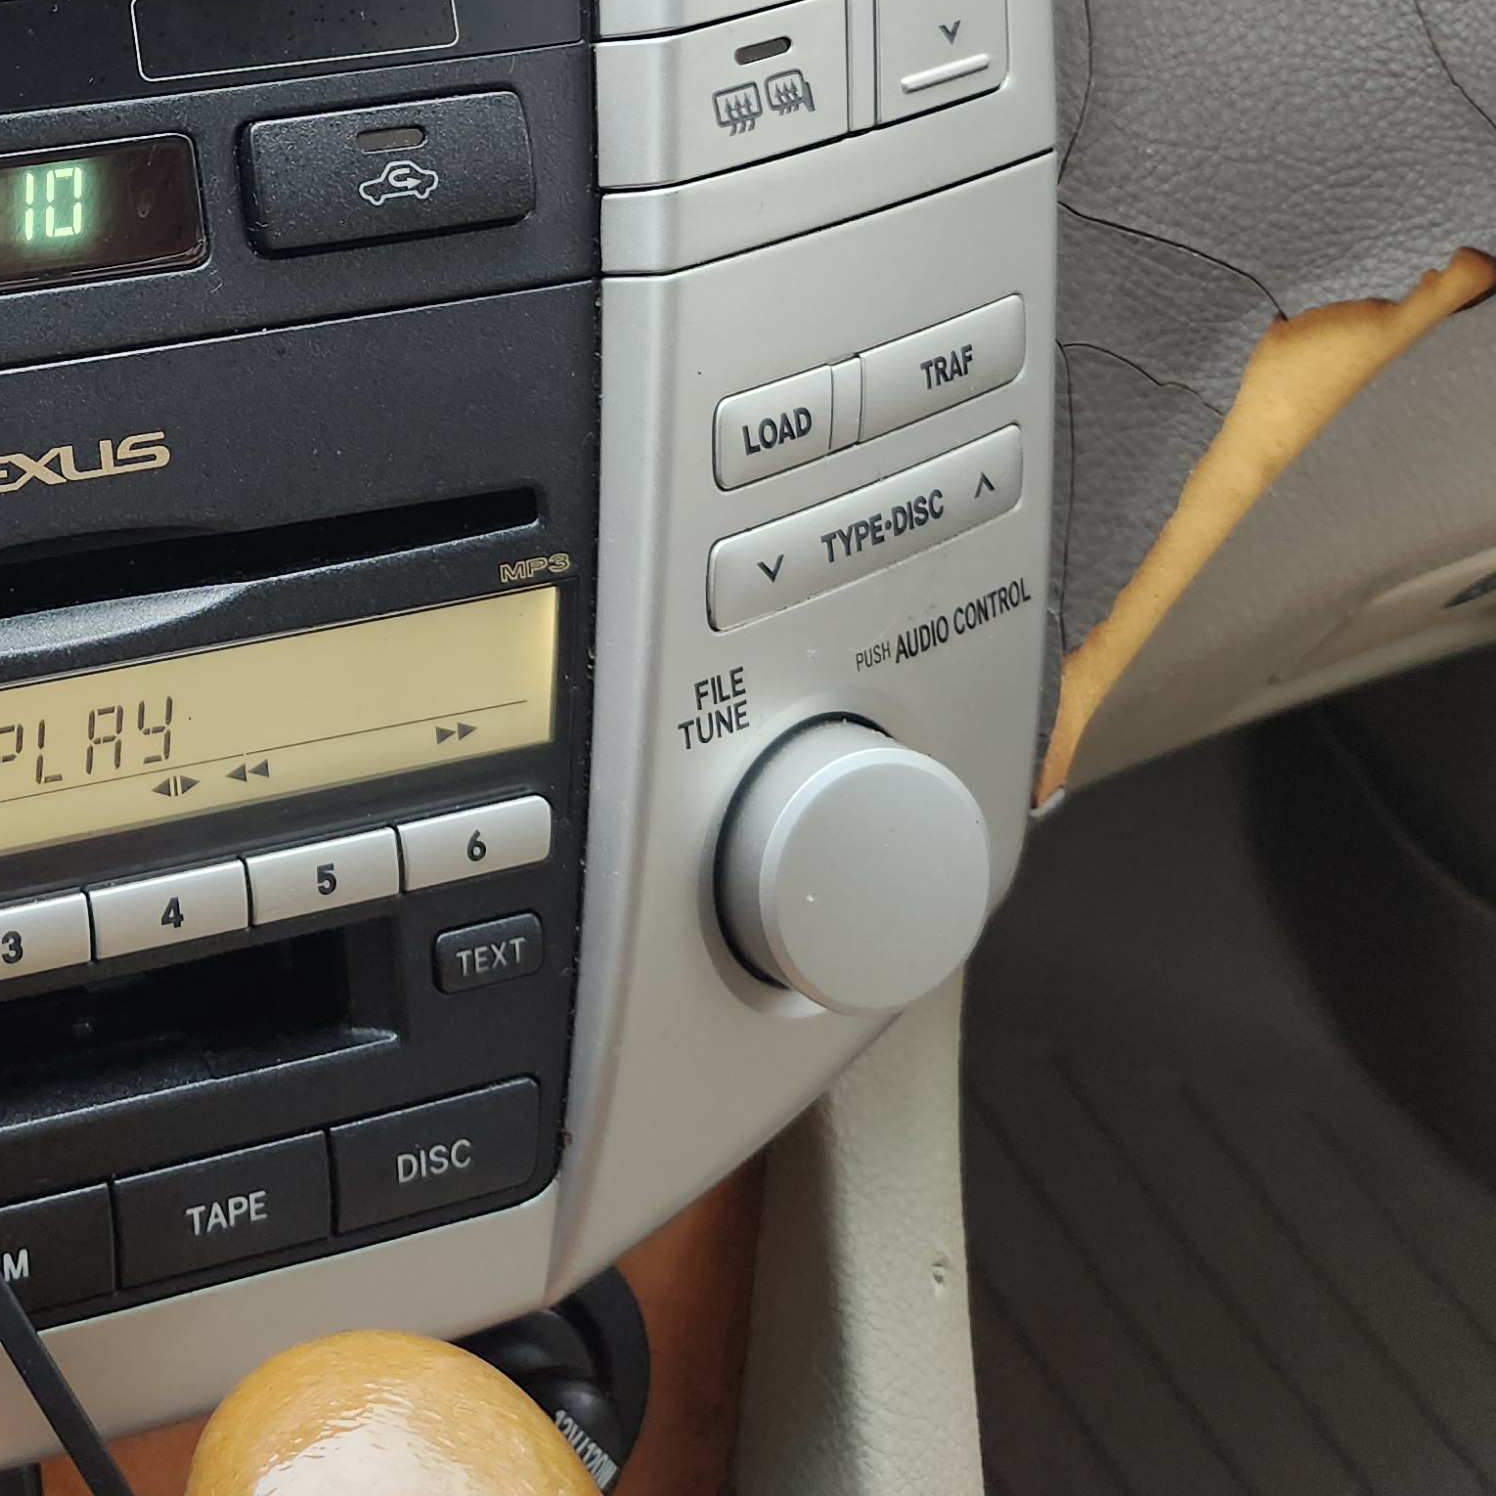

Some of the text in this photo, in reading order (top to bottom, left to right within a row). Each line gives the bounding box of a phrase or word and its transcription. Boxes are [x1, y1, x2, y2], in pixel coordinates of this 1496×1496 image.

[919, 343, 974, 391] TRAF
[741, 406, 812, 456] LOAD
[499, 553, 571, 584] MP3
[855, 577, 1032, 672] PUSH AUDIO CONTROL
[693, 665, 747, 711] FILE
[677, 699, 751, 751] TUNE
[465, 828, 488, 862] 6
[315, 862, 338, 896] 5
[160, 896, 185, 929] 4
[0, 930, 25, 965] 3
[455, 935, 527, 977] TEXT
[395, 1138, 473, 1184] DISC
[185, 1189, 268, 1237] TAPE
